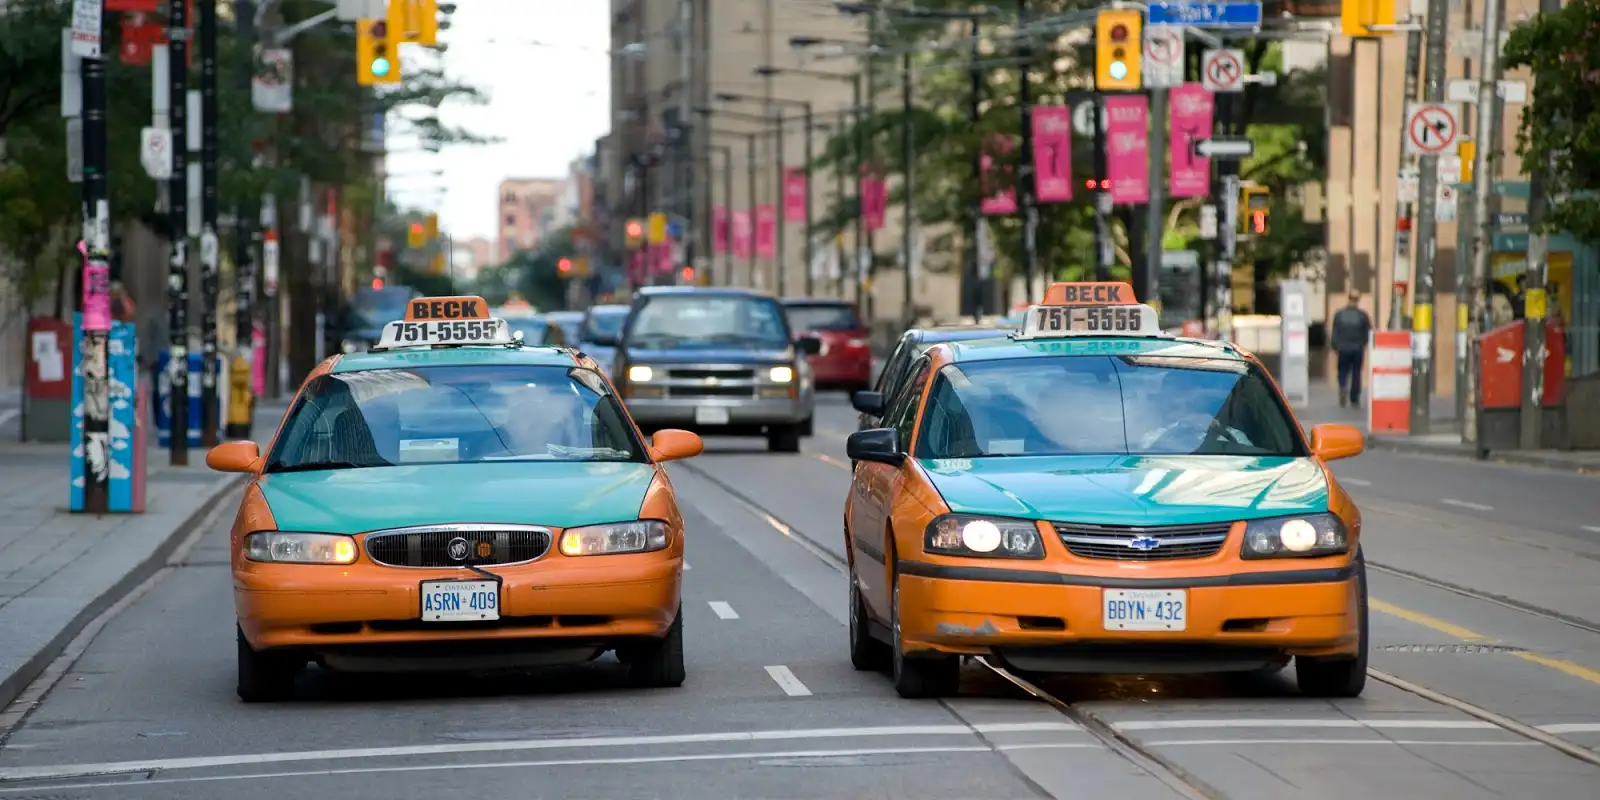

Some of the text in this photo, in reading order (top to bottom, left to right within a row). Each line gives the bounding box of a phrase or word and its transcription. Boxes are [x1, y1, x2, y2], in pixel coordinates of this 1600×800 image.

[1065, 285, 1121, 302] BECK
[413, 301, 478, 319] BECK
[1037, 307, 1141, 331] 751-5555
[393, 320, 496, 342] 751-5555
[425, 591, 496, 612] ASRN 409
[1108, 600, 1183, 621] BBYN 432
